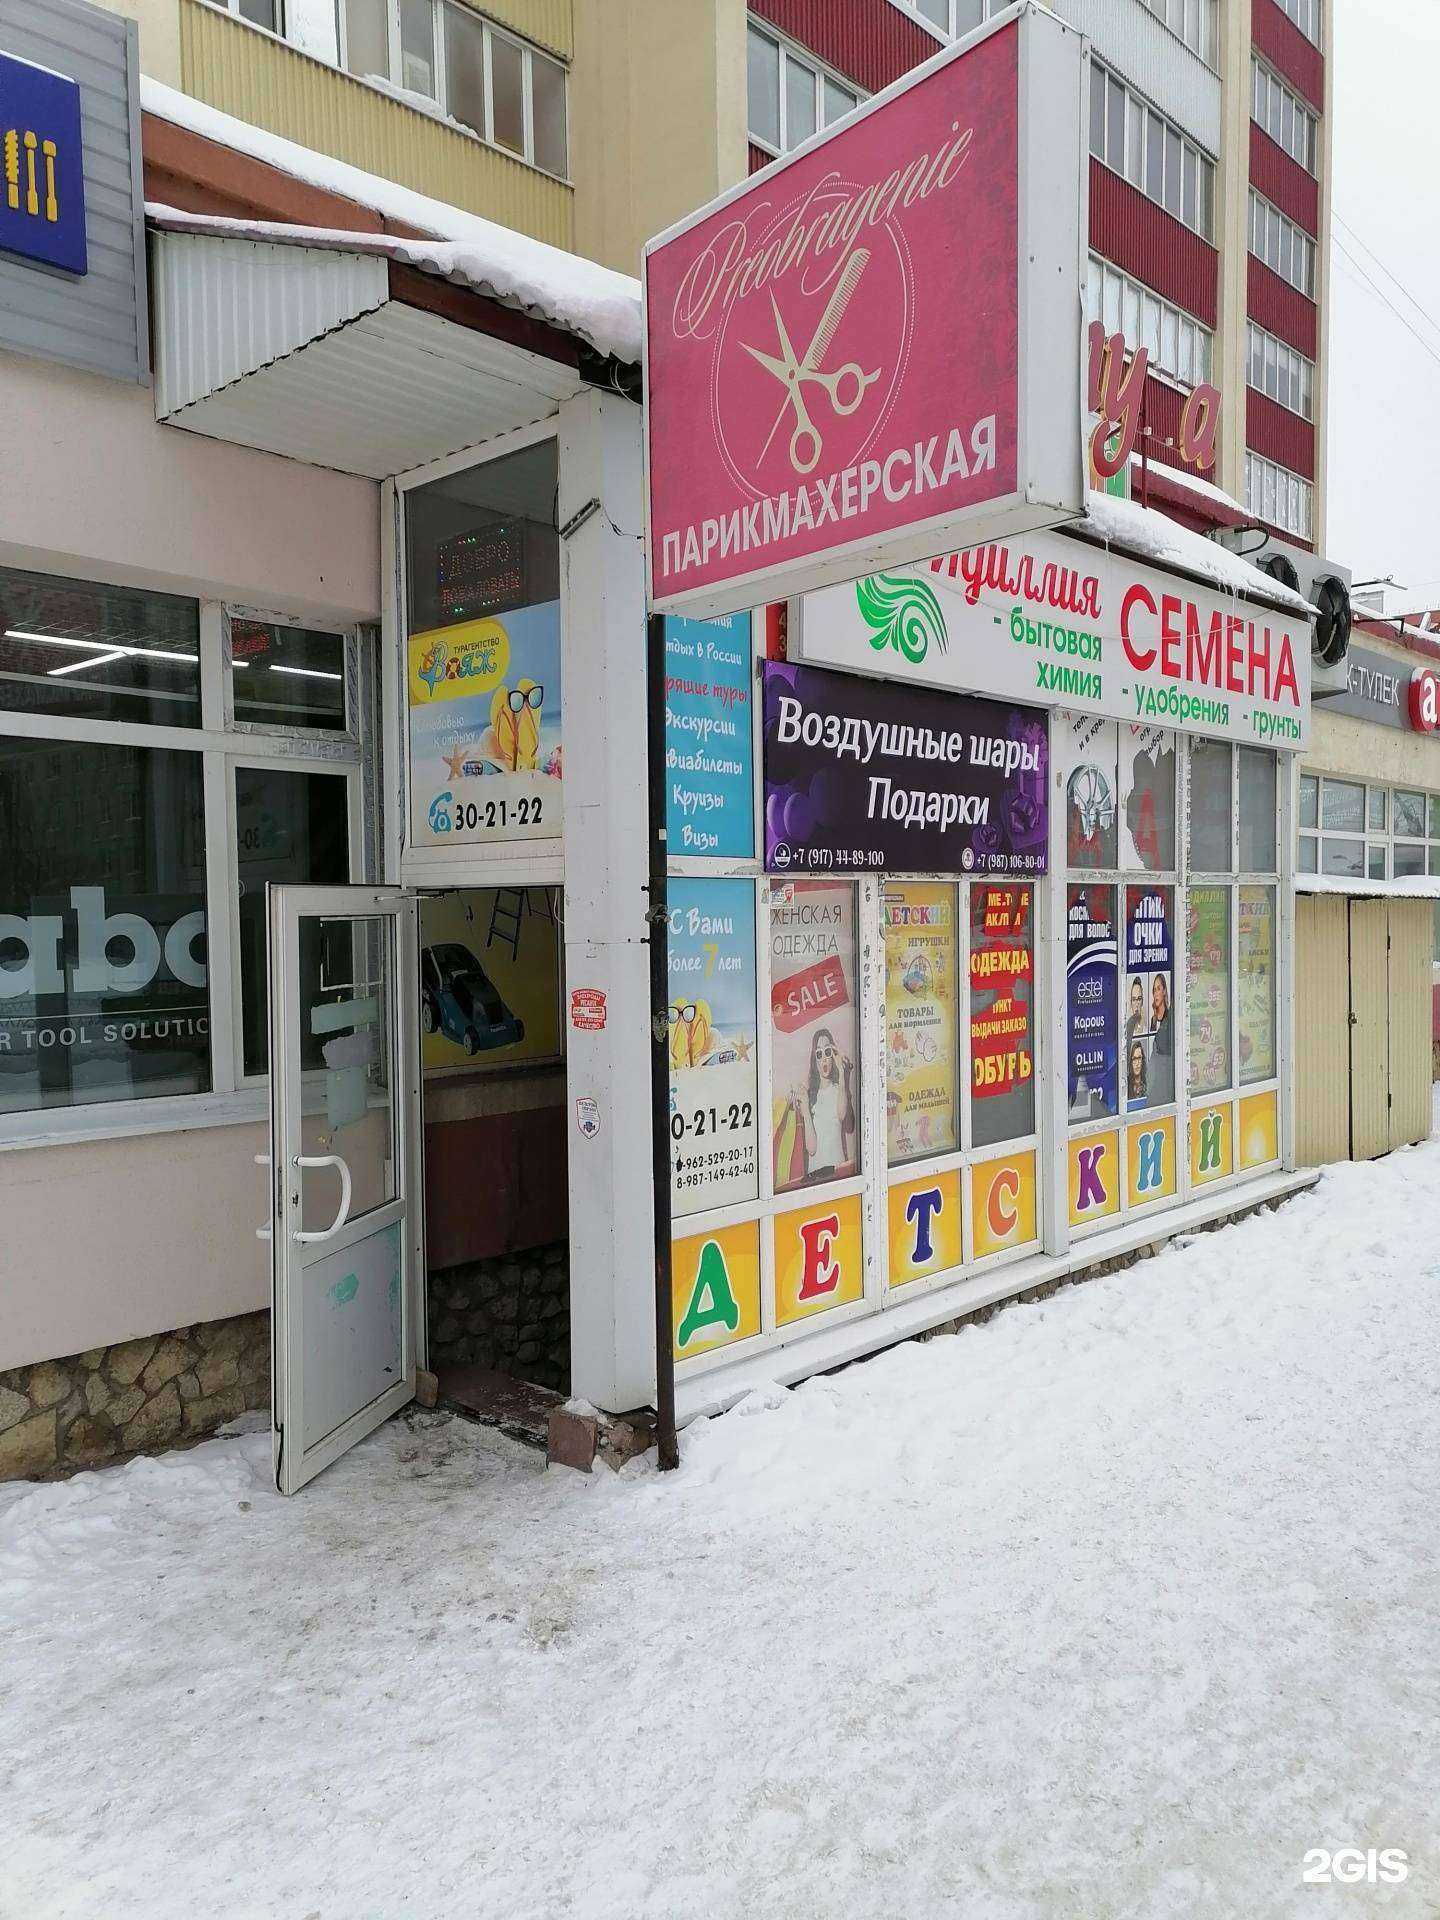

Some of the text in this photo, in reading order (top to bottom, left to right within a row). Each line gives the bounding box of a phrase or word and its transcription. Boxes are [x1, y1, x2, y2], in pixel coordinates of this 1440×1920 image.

[663, 414, 996, 577] ПАРИКМАХЕРСКАЯ
[1010, 606, 1102, 662] бытовая
[1120, 583, 1300, 707] СЕМЕНА
[666, 638, 694, 656] тдых
[707, 642, 742, 665] России
[665, 675, 747, 710] рящие туры
[1035, 660, 1102, 701] химия
[665, 706, 737, 741] Экскурсии
[1134, 683, 1229, 726] удобрения
[1252, 710, 1302, 741] грунты
[777, 696, 1040, 778] Воздушные шары
[673, 784, 725, 815] Круизы
[867, 776, 990, 833] Подарки
[455, 797, 543, 831] 30-21-22
[682, 825, 719, 850] Визы
[808, 848, 833, 867] (917)
[686, 906, 733, 936] Вами
[771, 904, 843, 926] ЖЕНСКАЯ
[772, 933, 839, 957] ОДЕЖДА
[1133, 922, 1163, 946] ОЧКИ
[718, 953, 742, 971] лет
[971, 950, 1030, 978] ОДЕЖДА
[1128, 947, 1168, 966] ДЛЯ ЗРЕНИЯ
[787, 972, 838, 1017] SALE
[1077, 976, 1104, 998] estel
[1001, 1016, 1027, 1034] ЗАКАЗО
[1074, 1015, 1105, 1033] Kapous
[21, 1027, 92, 1050] TOOL
[1076, 1050, 1104, 1066] OLLIN
[670, 1102, 752, 1141] 0-21-22
[675, 1146, 754, 1174] -962-529-20-17
[676, 1163, 754, 1189] 8-987-149-42-40
[678, 1110, 1224, 1348] ДЕТСКИЙ
